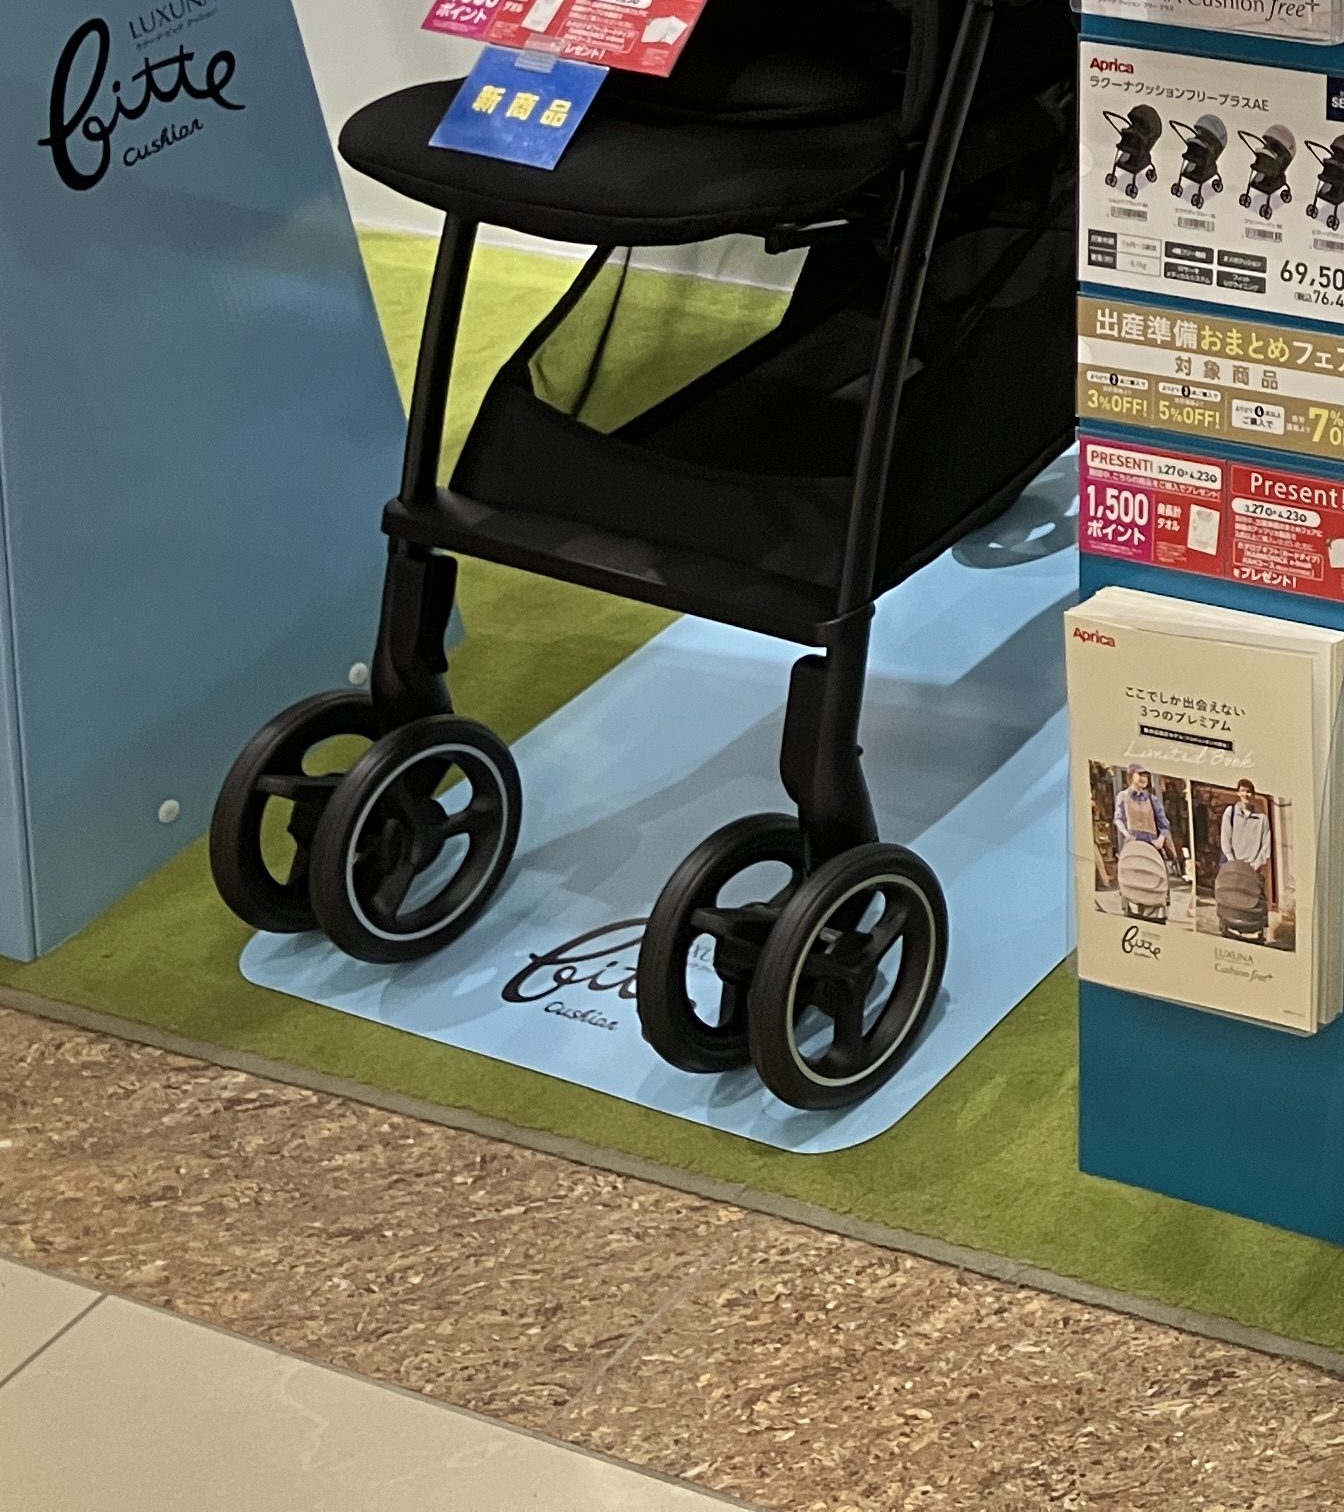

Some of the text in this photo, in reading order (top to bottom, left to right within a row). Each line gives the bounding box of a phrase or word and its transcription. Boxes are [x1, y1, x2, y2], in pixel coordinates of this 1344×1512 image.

[435, 2, 488, 25] ポイント
[1089, 57, 1134, 75] Aprica
[37, 17, 246, 191] bitte
[472, 84, 572, 128] 新商品
[1089, 76, 1270, 112] ラクーナクッションフリープラスAE
[1174, 355, 1279, 390] 対象商品
[1087, 389, 1148, 417] 3%OFF!
[1159, 400, 1220, 429] 5%OFF!
[1242, 416, 1273, 429] ご購入で
[1091, 451, 1153, 473] PRESENT!
[1087, 484, 1149, 527] 1,500
[1087, 520, 1146, 545] ポイント
[1157, 518, 1180, 532] タオル
[1073, 627, 1116, 647] Aprica
[1124, 686, 1246, 717] ここでしか出会えない
[1140, 705, 1232, 732] 3つのプレミアム
